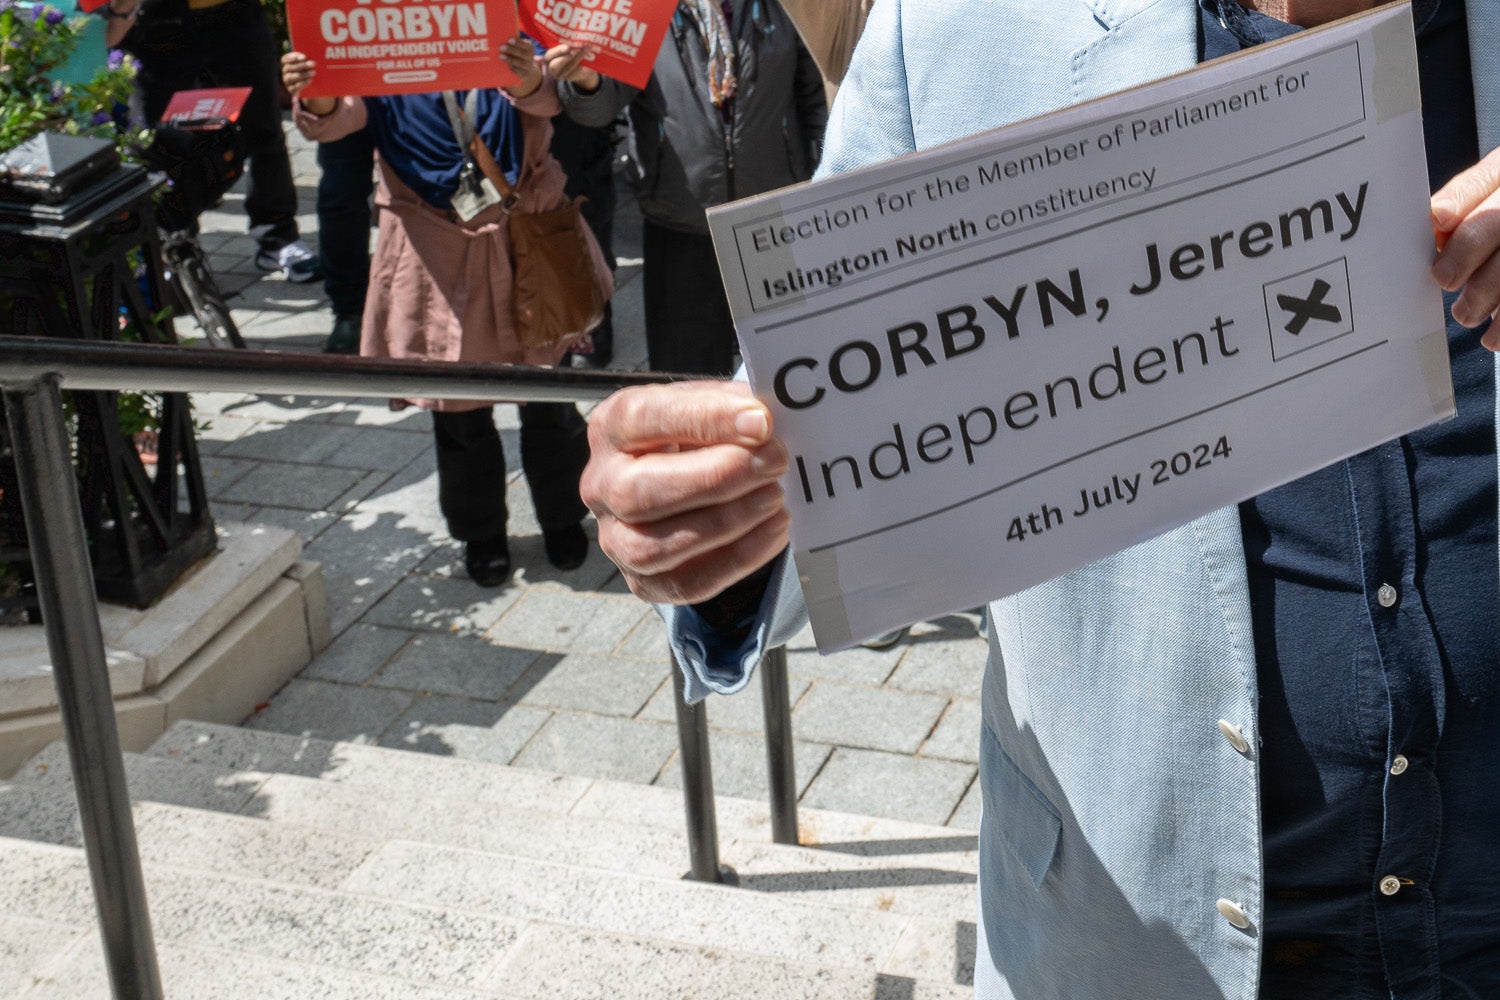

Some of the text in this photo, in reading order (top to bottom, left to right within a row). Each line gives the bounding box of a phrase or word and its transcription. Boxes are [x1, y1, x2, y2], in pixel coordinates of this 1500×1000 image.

[320, 2, 489, 44] CORBYN
[325, 38, 489, 60] AN INDEPENDENT VOICE
[750, 69, 1311, 254] Election for the Member of Parliament for
[762, 167, 1157, 299] Islington North constituency
[771, 180, 1370, 411] CORBYN, Jeremy
[793, 312, 1240, 504] Independent
[1006, 435, 1233, 543] 4th July 2024
